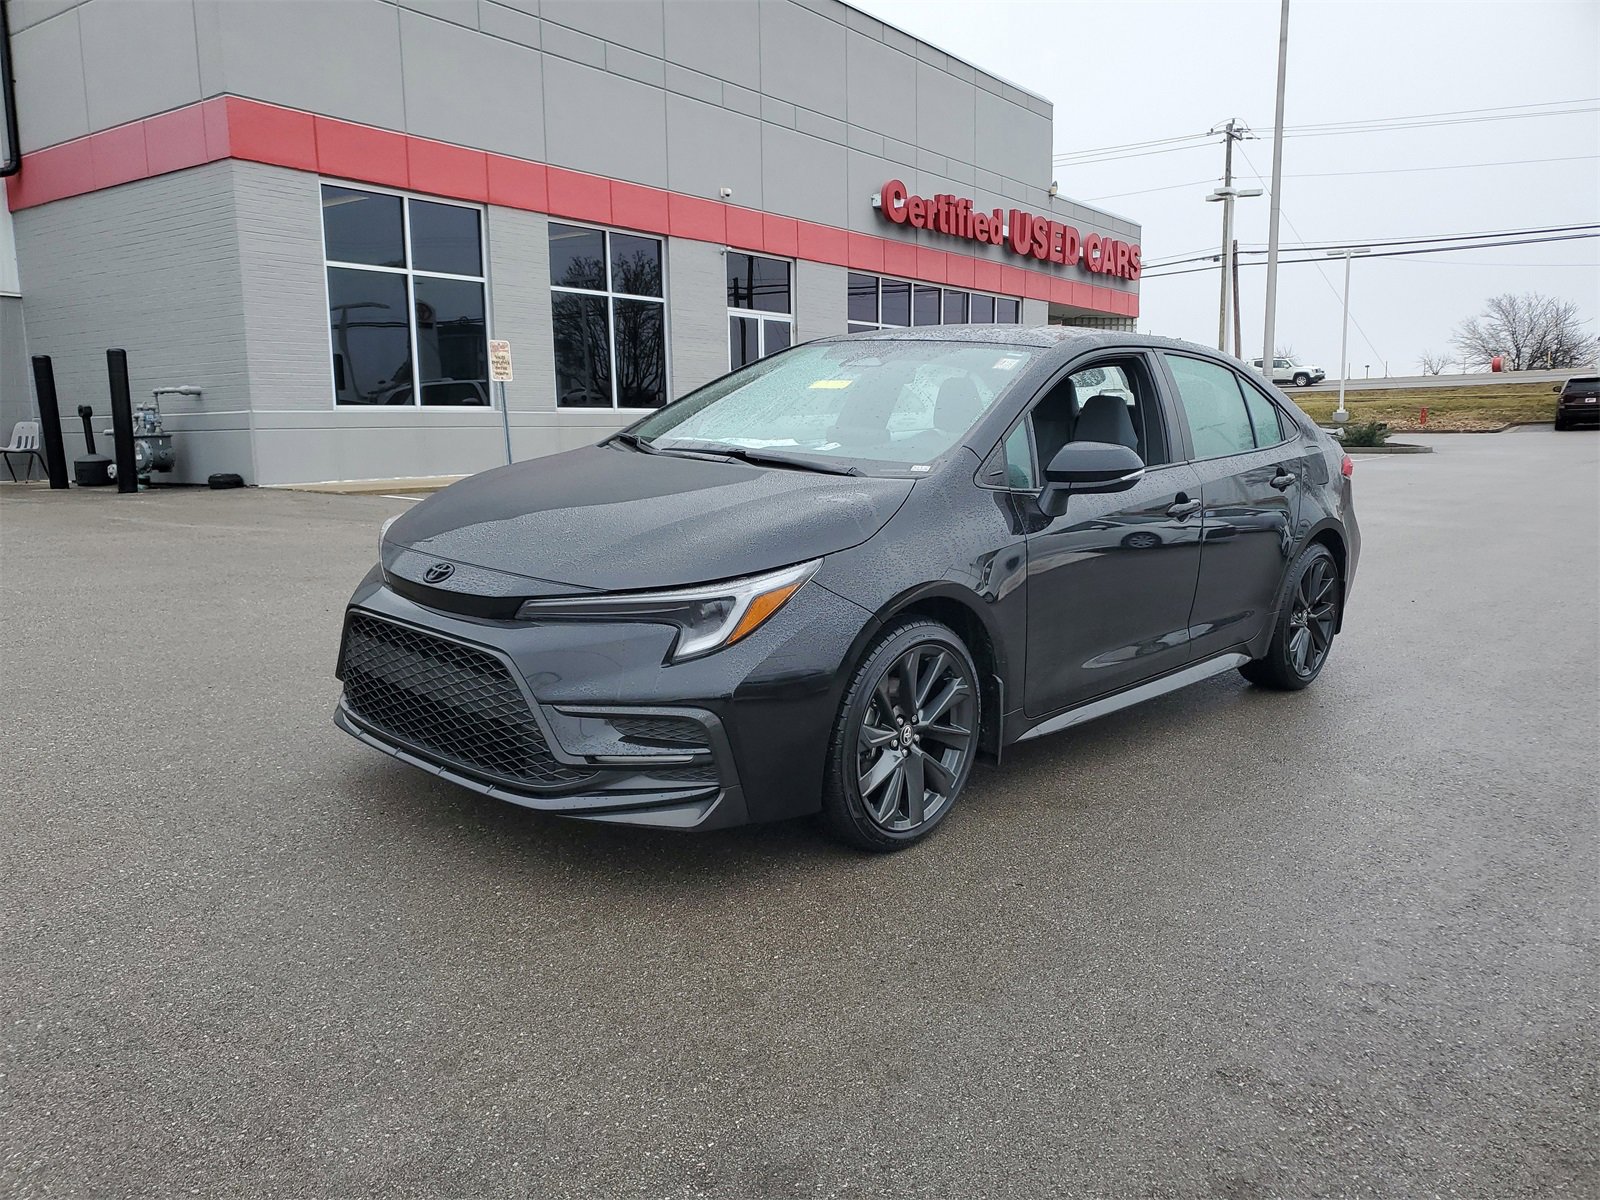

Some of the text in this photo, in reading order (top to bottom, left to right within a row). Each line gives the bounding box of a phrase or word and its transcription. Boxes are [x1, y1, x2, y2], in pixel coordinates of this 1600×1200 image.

[881, 179, 1141, 281] Certified USED CARS
